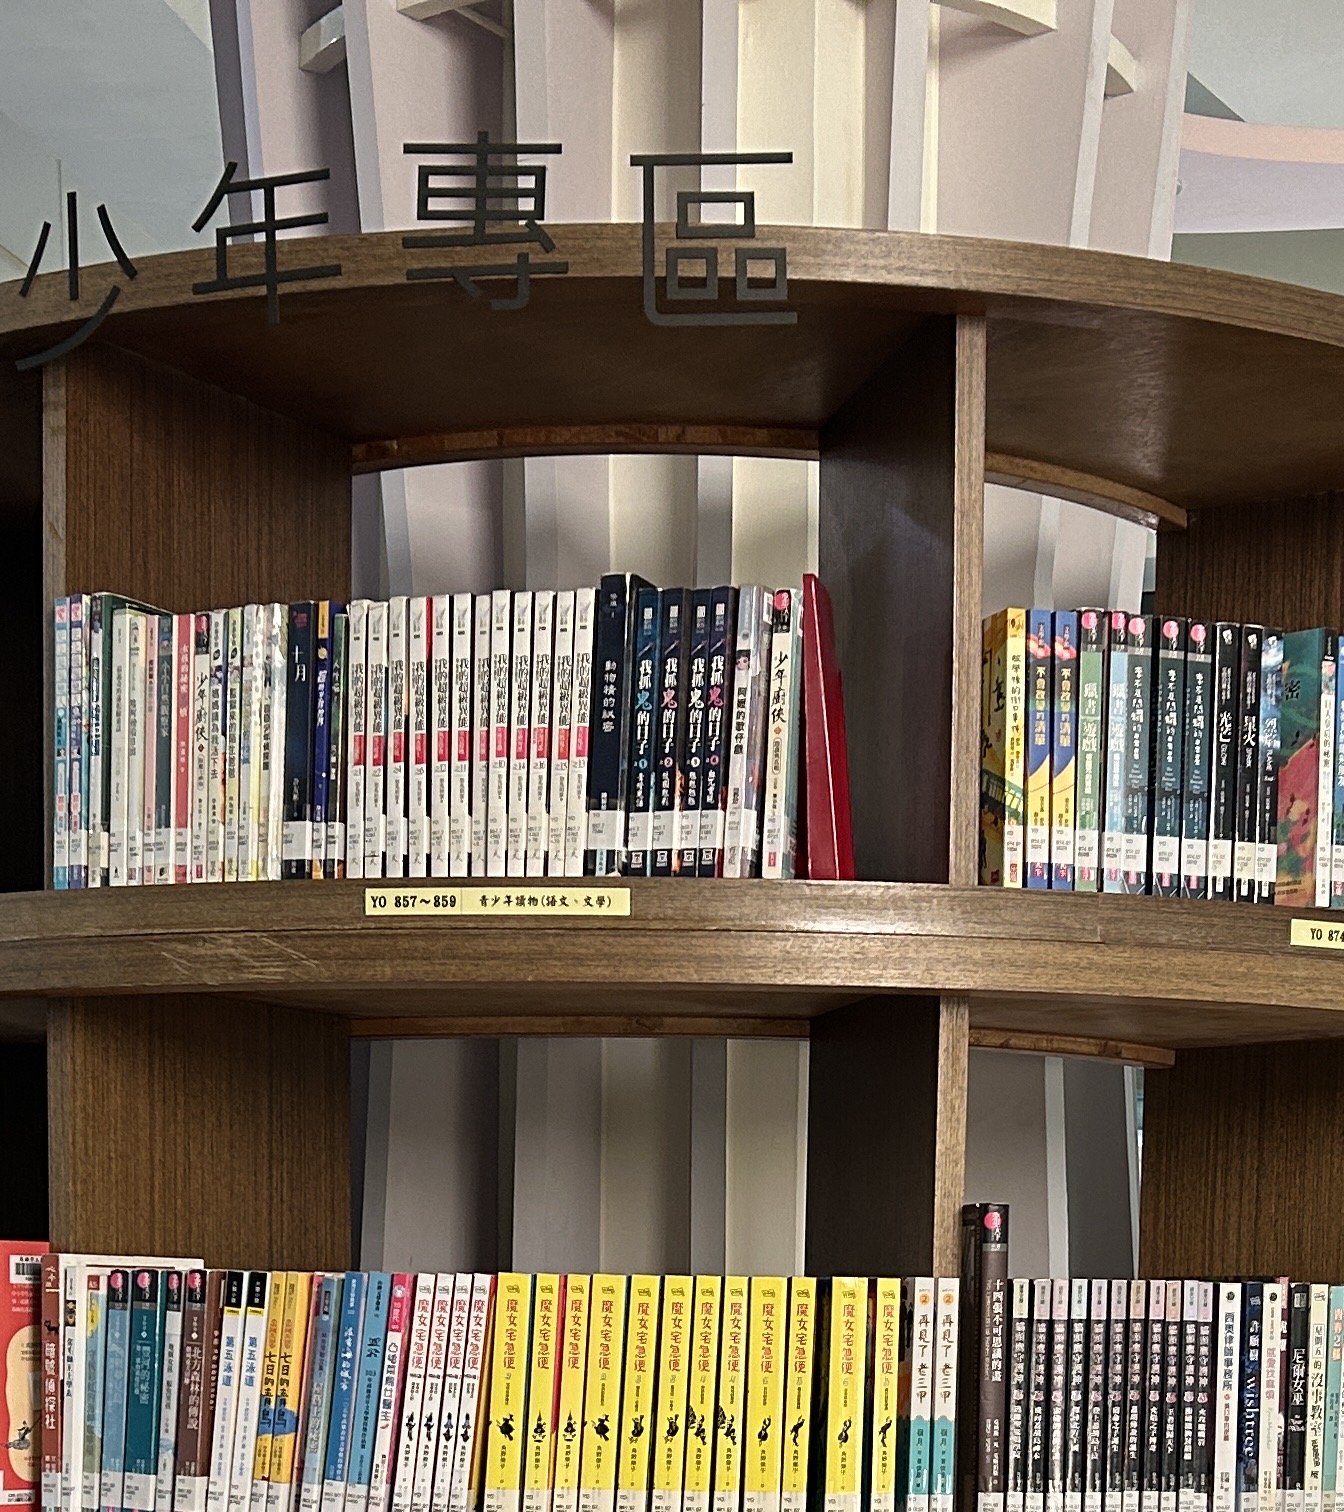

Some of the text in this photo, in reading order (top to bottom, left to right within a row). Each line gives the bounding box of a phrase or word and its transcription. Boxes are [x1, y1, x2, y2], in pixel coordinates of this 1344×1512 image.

[290, 644, 307, 682] 十月
[370, 895, 388, 909] YO
[1309, 927, 1324, 942] YO
[411, 1299, 430, 1370] 魔女宅急便
[430, 1299, 449, 1370] 魔女宅急便
[449, 1299, 468, 1370] 魔女宅急便
[468, 1299, 486, 1370] 魔女宅急便
[503, 1298, 519, 1370] 魔女宅急便
[537, 1298, 553, 1370] 魔女宅急便
[567, 1298, 582, 1370] 魔女宅急便
[598, 1299, 613, 1371] 魔女宅急便
[633, 1303, 650, 1372] 魔女宅急便
[668, 1303, 684, 1372] 魔女宅急便
[697, 1303, 713, 1373] 魔女宅急便
[727, 1302, 743, 1375] 魔女宅急便
[760, 1302, 776, 1375] 魔女宅急便
[794, 1302, 809, 1375] 魔女宅急便
[841, 1304, 856, 1376] 魔女宅急便
[881, 1304, 895, 1376] 魔女宅急便
